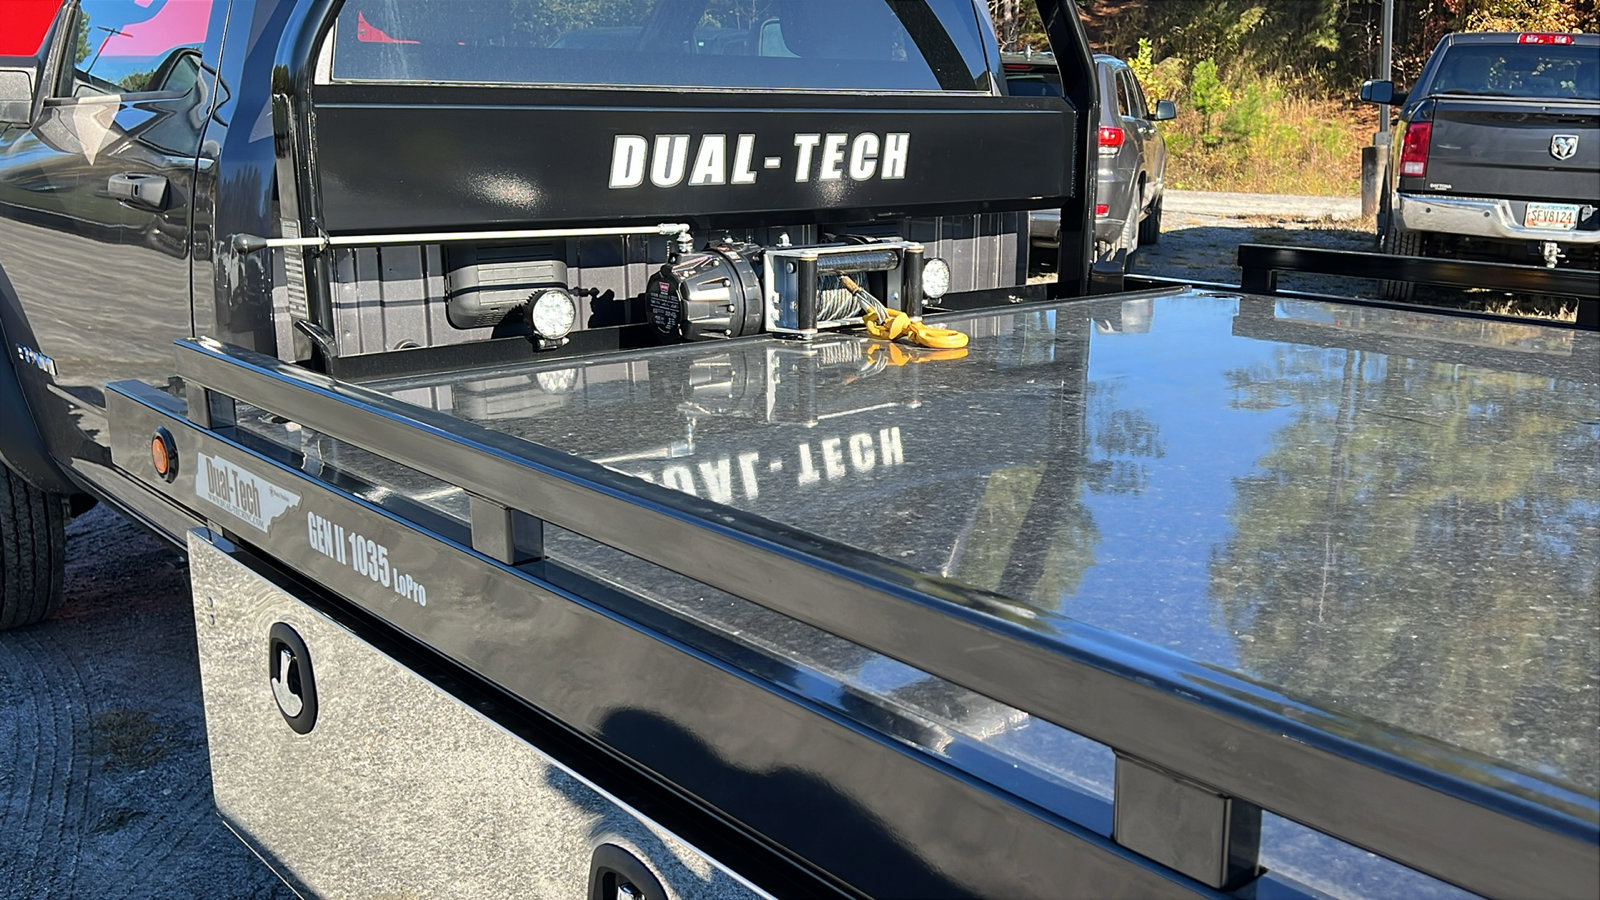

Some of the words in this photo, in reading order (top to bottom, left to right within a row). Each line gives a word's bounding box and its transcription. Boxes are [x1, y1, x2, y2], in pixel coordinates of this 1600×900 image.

[793, 131, 911, 183] TECH
[205, 456, 262, 519] Dual-Tech
[307, 511, 334, 559] GEN
[333, 523, 347, 566] II
[348, 532, 391, 588] 1035
[392, 567, 427, 607] LoPro
